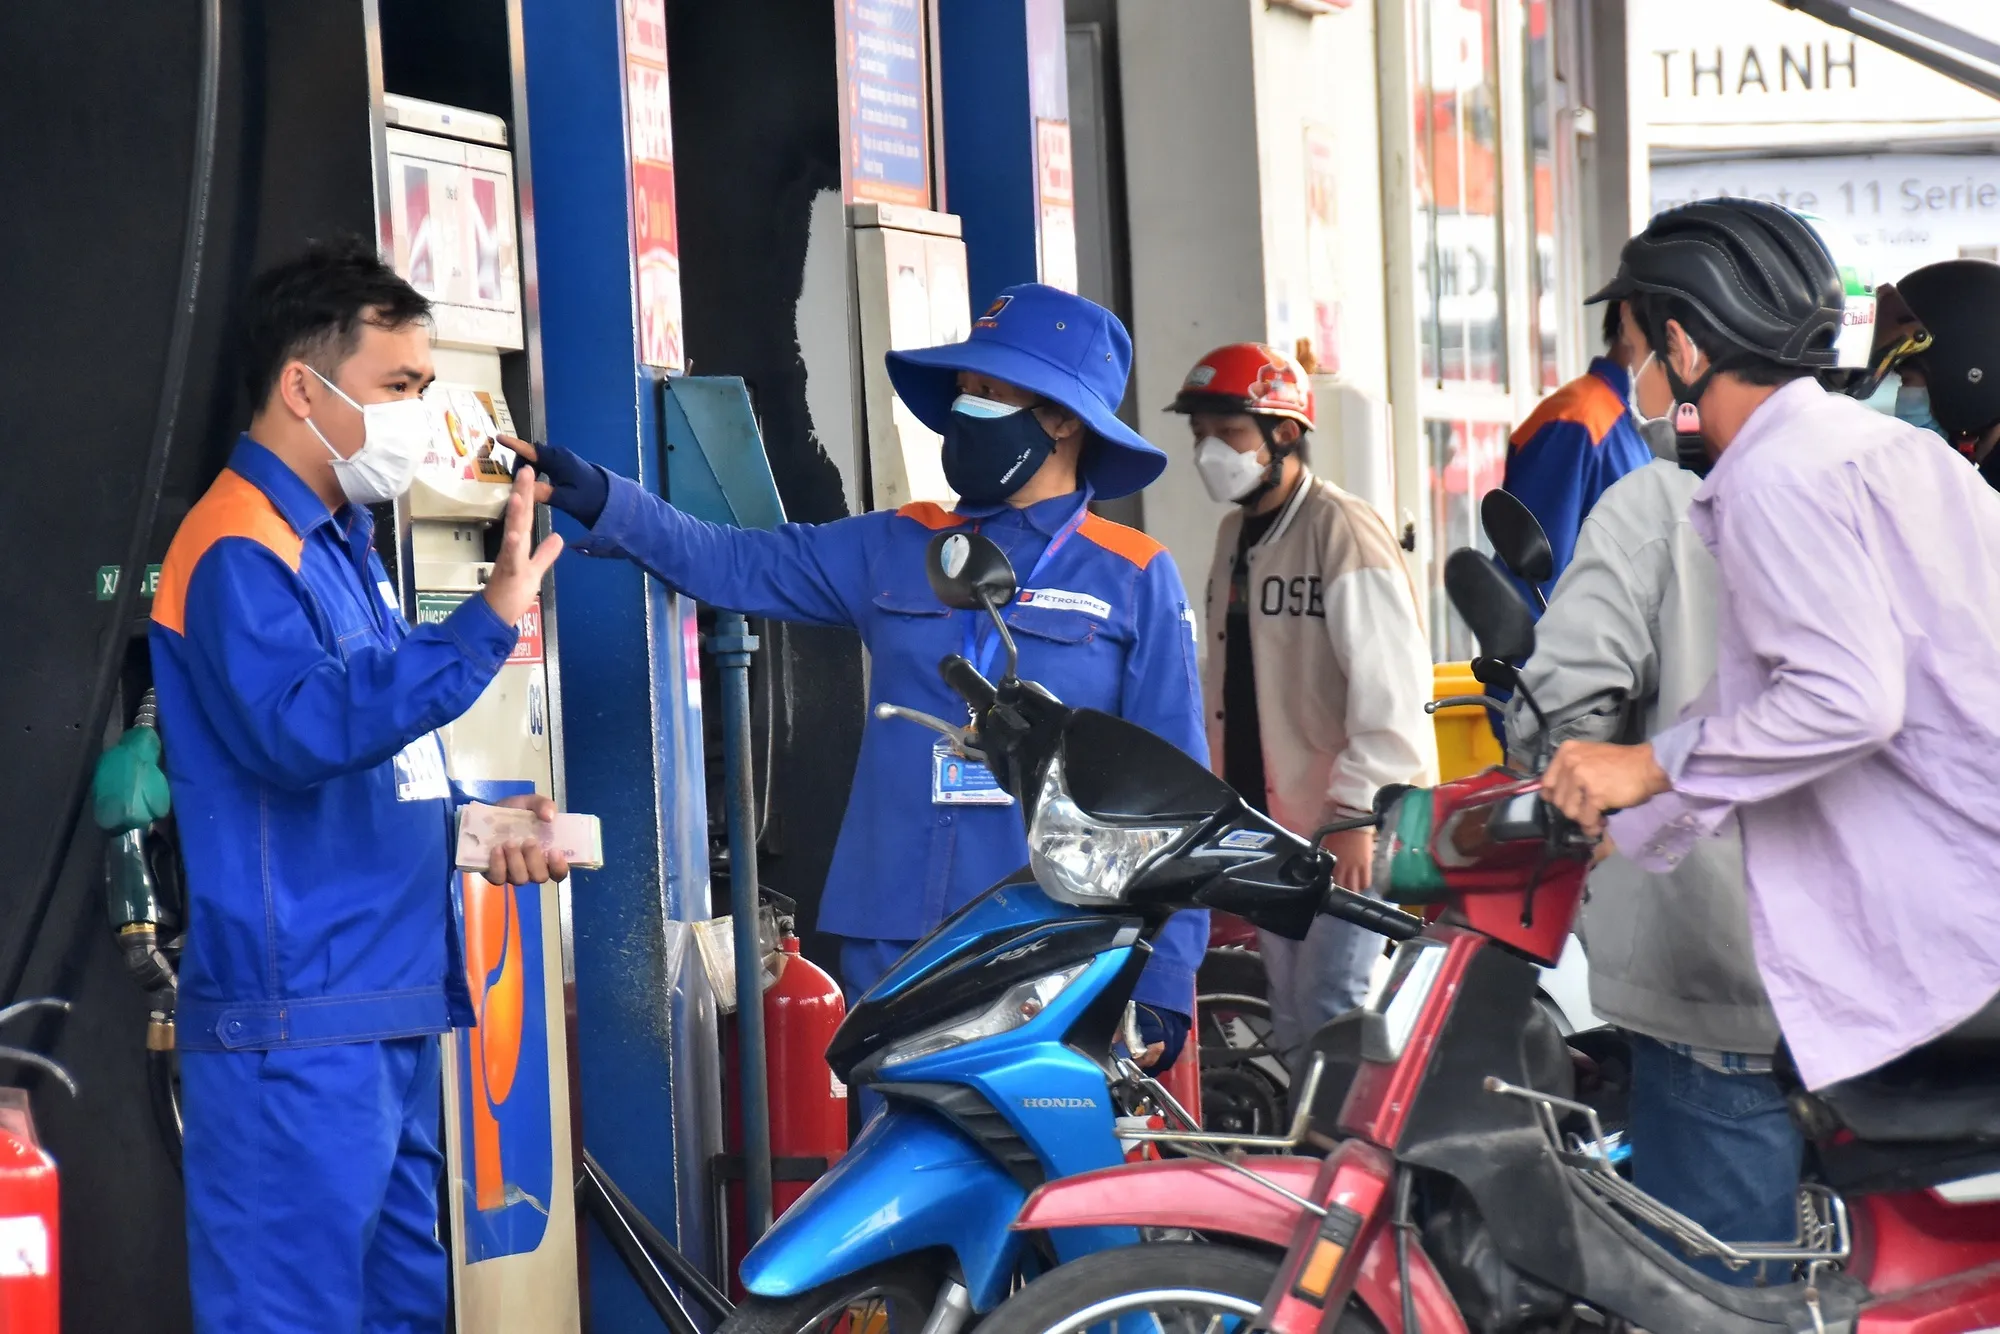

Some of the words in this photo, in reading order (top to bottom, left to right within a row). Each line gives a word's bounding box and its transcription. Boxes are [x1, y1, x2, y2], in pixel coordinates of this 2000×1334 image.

[1652, 41, 1857, 98] THANH
[1838, 180, 1882, 214] 11
[1036, 593, 1107, 613] PETROLIMEX
[529, 684, 543, 736] 03
[1023, 1097, 1097, 1108] HONDA
